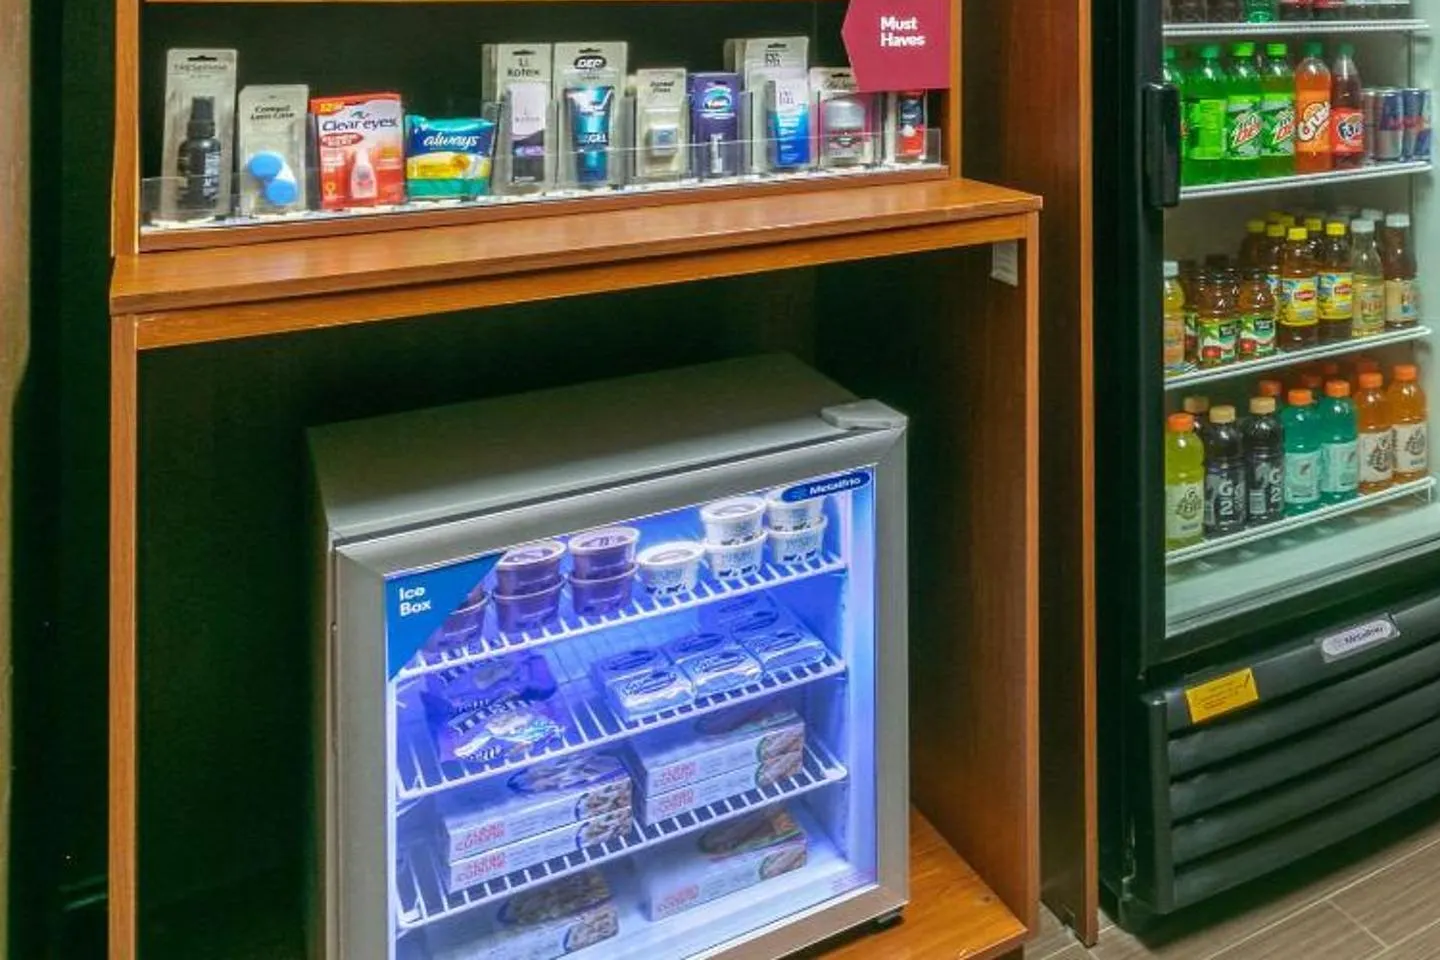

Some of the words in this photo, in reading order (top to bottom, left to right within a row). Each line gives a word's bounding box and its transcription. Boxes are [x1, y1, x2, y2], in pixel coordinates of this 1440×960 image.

[880, 16, 918, 31] Must
[880, 32, 926, 48] Haves
[321, 119, 360, 132] Clear
[423, 132, 481, 151] always
[399, 586, 426, 601] Ice
[399, 601, 432, 617] Box
